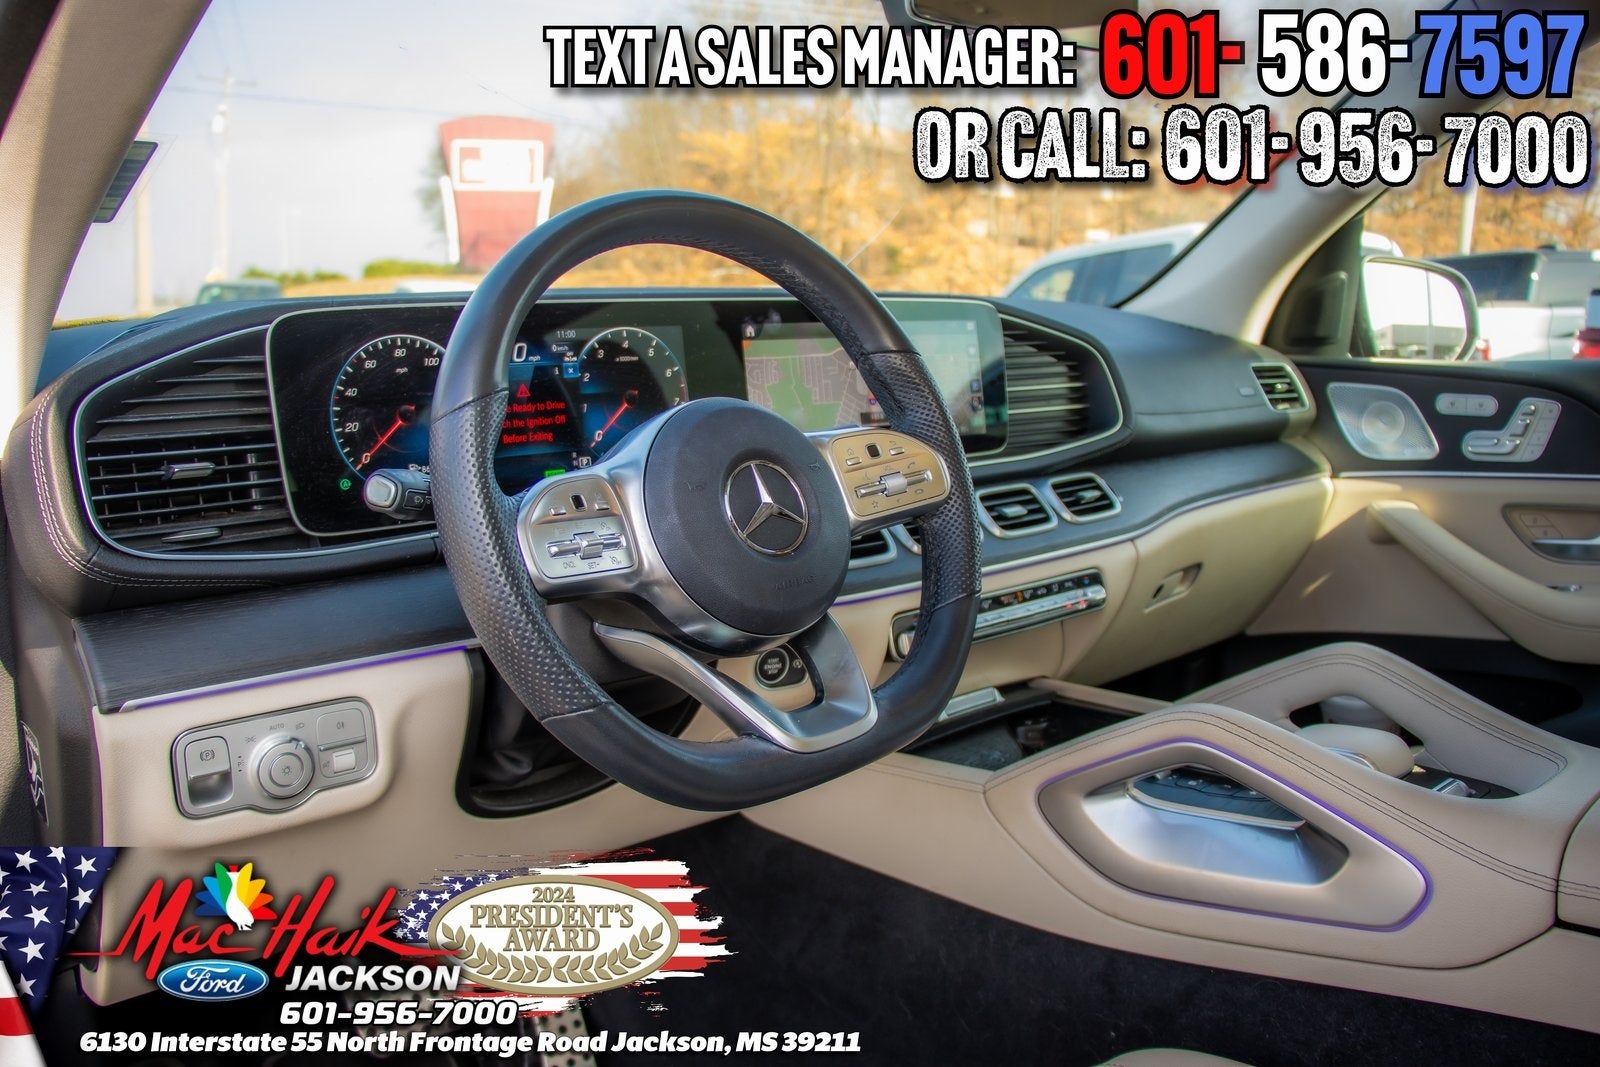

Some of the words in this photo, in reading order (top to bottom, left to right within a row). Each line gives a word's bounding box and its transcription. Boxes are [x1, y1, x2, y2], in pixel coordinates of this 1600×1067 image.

[557, 330, 576, 338] 11:00
[622, 340, 629, 348] 4
[394, 349, 406, 357] 80
[513, 343, 527, 362] 0
[597, 350, 604, 358] 3
[648, 348, 654, 356] 5
[364, 360, 377, 369] 60
[423, 358, 440, 367] 100
[583, 373, 590, 382] 2
[665, 369, 672, 377] 6
[345, 388, 358, 397] 40
[673, 397, 680, 406] 7
[513, 402, 536, 412] Ready
[546, 401, 565, 409] Drive
[583, 403, 588, 413] 1
[526, 417, 553, 429] Ignition
[555, 415, 566, 424] Off
[345, 423, 359, 432] 20
[503, 434, 527, 443] Before
[529, 432, 553, 441] Exiting
[595, 430, 602, 441] 0
[362, 452, 370, 463] 0
[269, 722, 285, 731] AUTO
